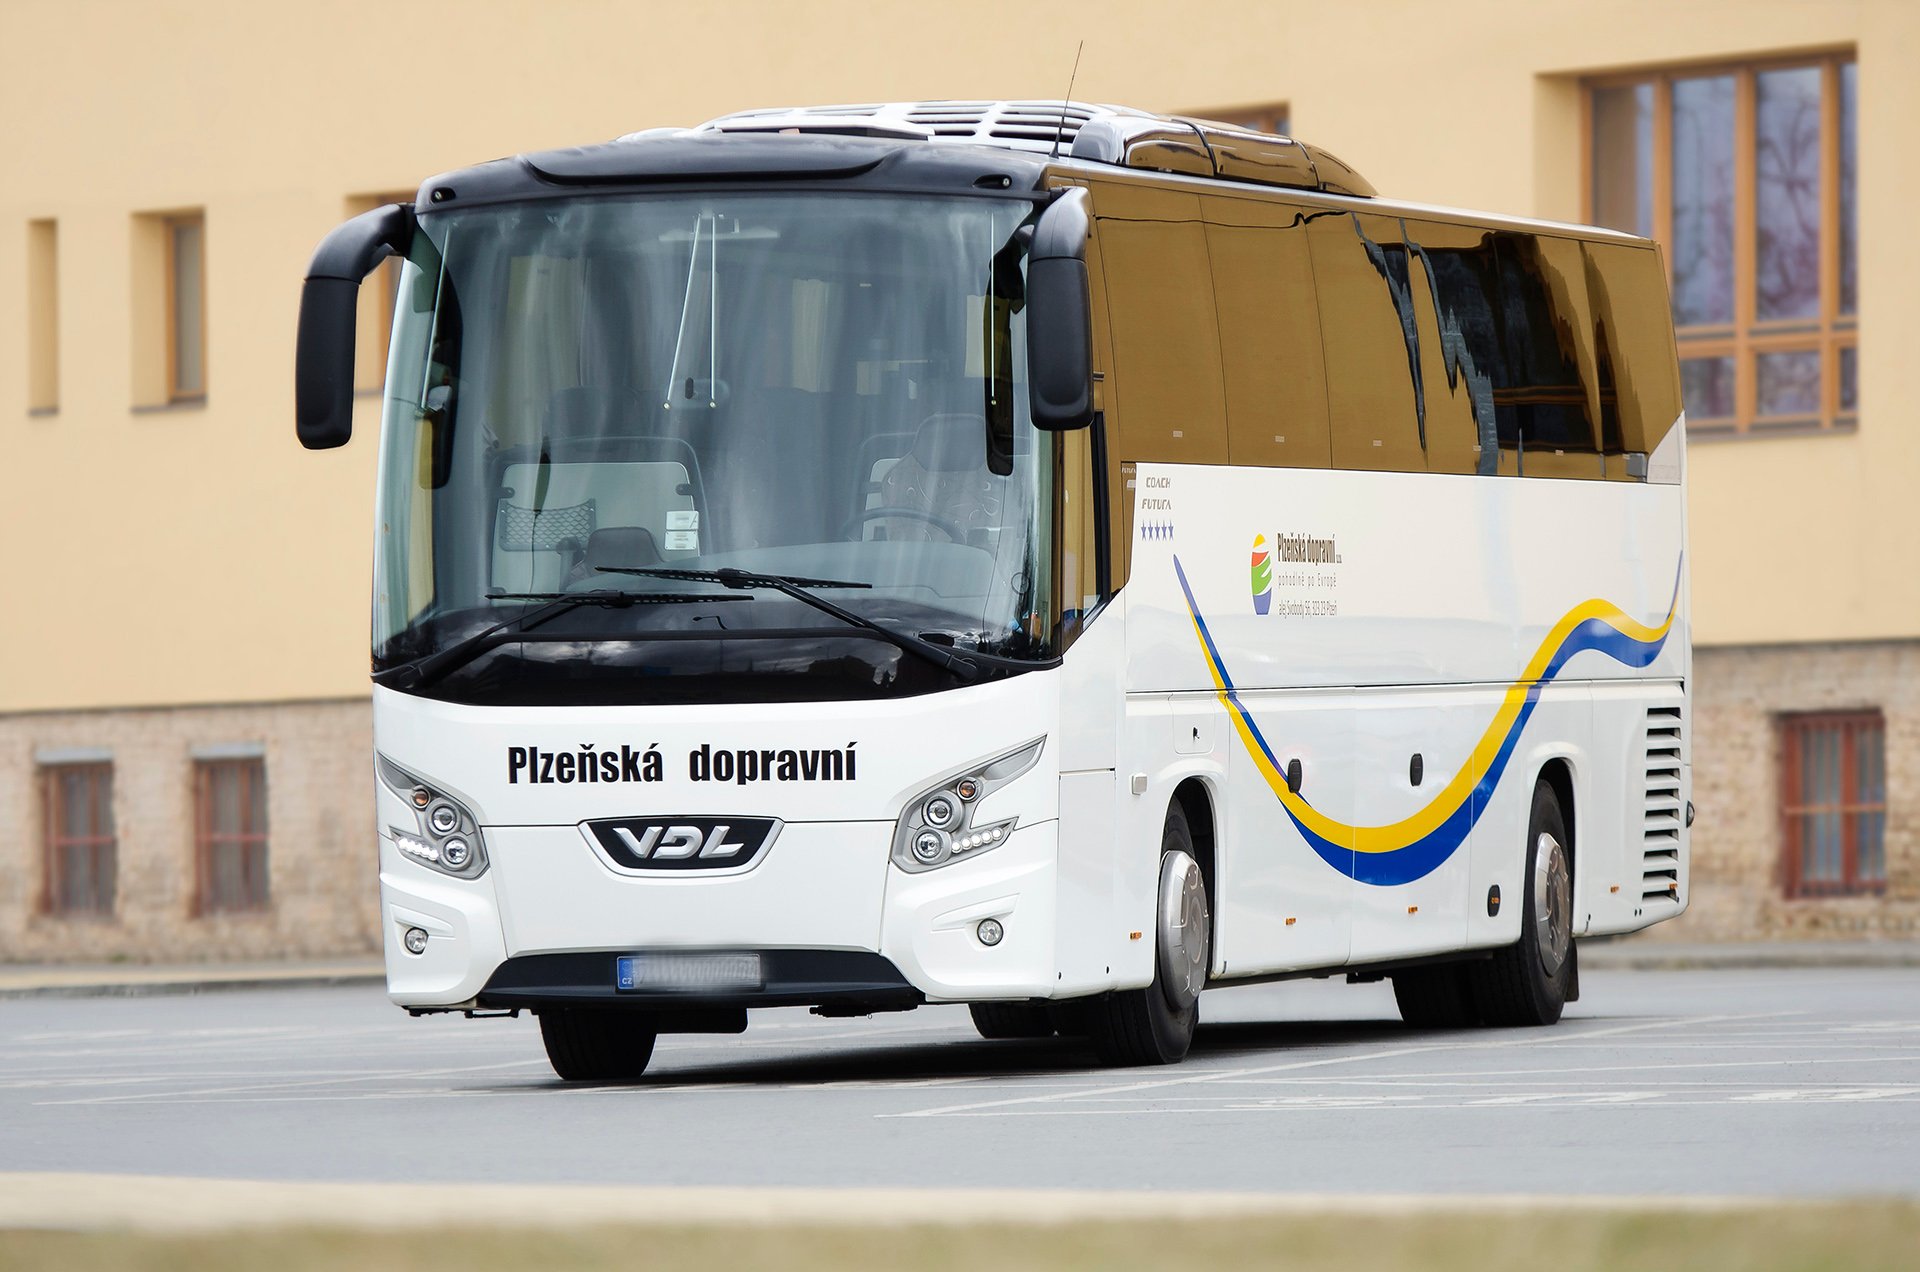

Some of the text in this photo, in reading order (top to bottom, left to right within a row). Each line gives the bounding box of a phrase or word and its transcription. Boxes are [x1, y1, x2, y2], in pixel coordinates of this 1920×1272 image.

[1146, 476, 1171, 489] COACH
[1277, 532, 1335, 566] Plzeňská dopravní
[1308, 575, 1315, 590] po
[508, 740, 858, 785] Plzeňská dopravní
[612, 825, 744, 860] VDL
[622, 977, 633, 985] CZ
